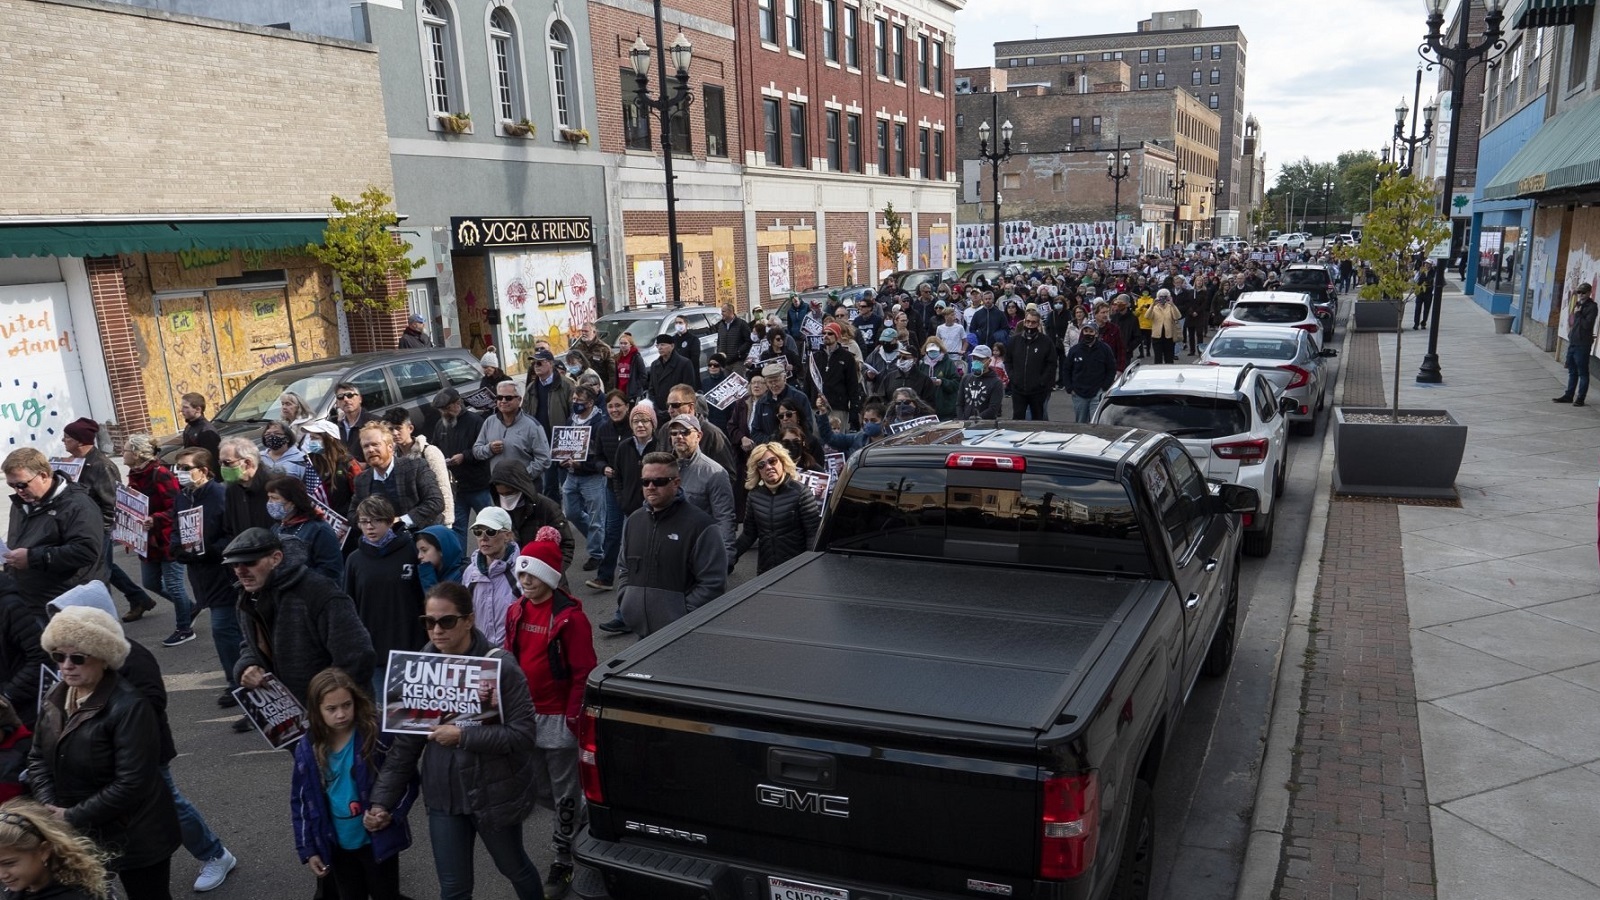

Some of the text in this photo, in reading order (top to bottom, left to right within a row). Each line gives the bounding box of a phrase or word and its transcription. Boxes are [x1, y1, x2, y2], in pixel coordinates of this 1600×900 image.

[482, 222, 590, 243] YOGA & FRIENDS
[535, 278, 567, 304] BLM
[173, 315, 191, 331] Exit
[506, 313, 528, 334] WE
[8, 331, 73, 357] stand
[560, 430, 585, 440] UNITE
[404, 660, 482, 689] UNITE
[402, 683, 481, 702] KENOSHA
[402, 697, 481, 714] WISCONSIN
[756, 783, 849, 818] GMC
[625, 820, 708, 844] SIERRA
